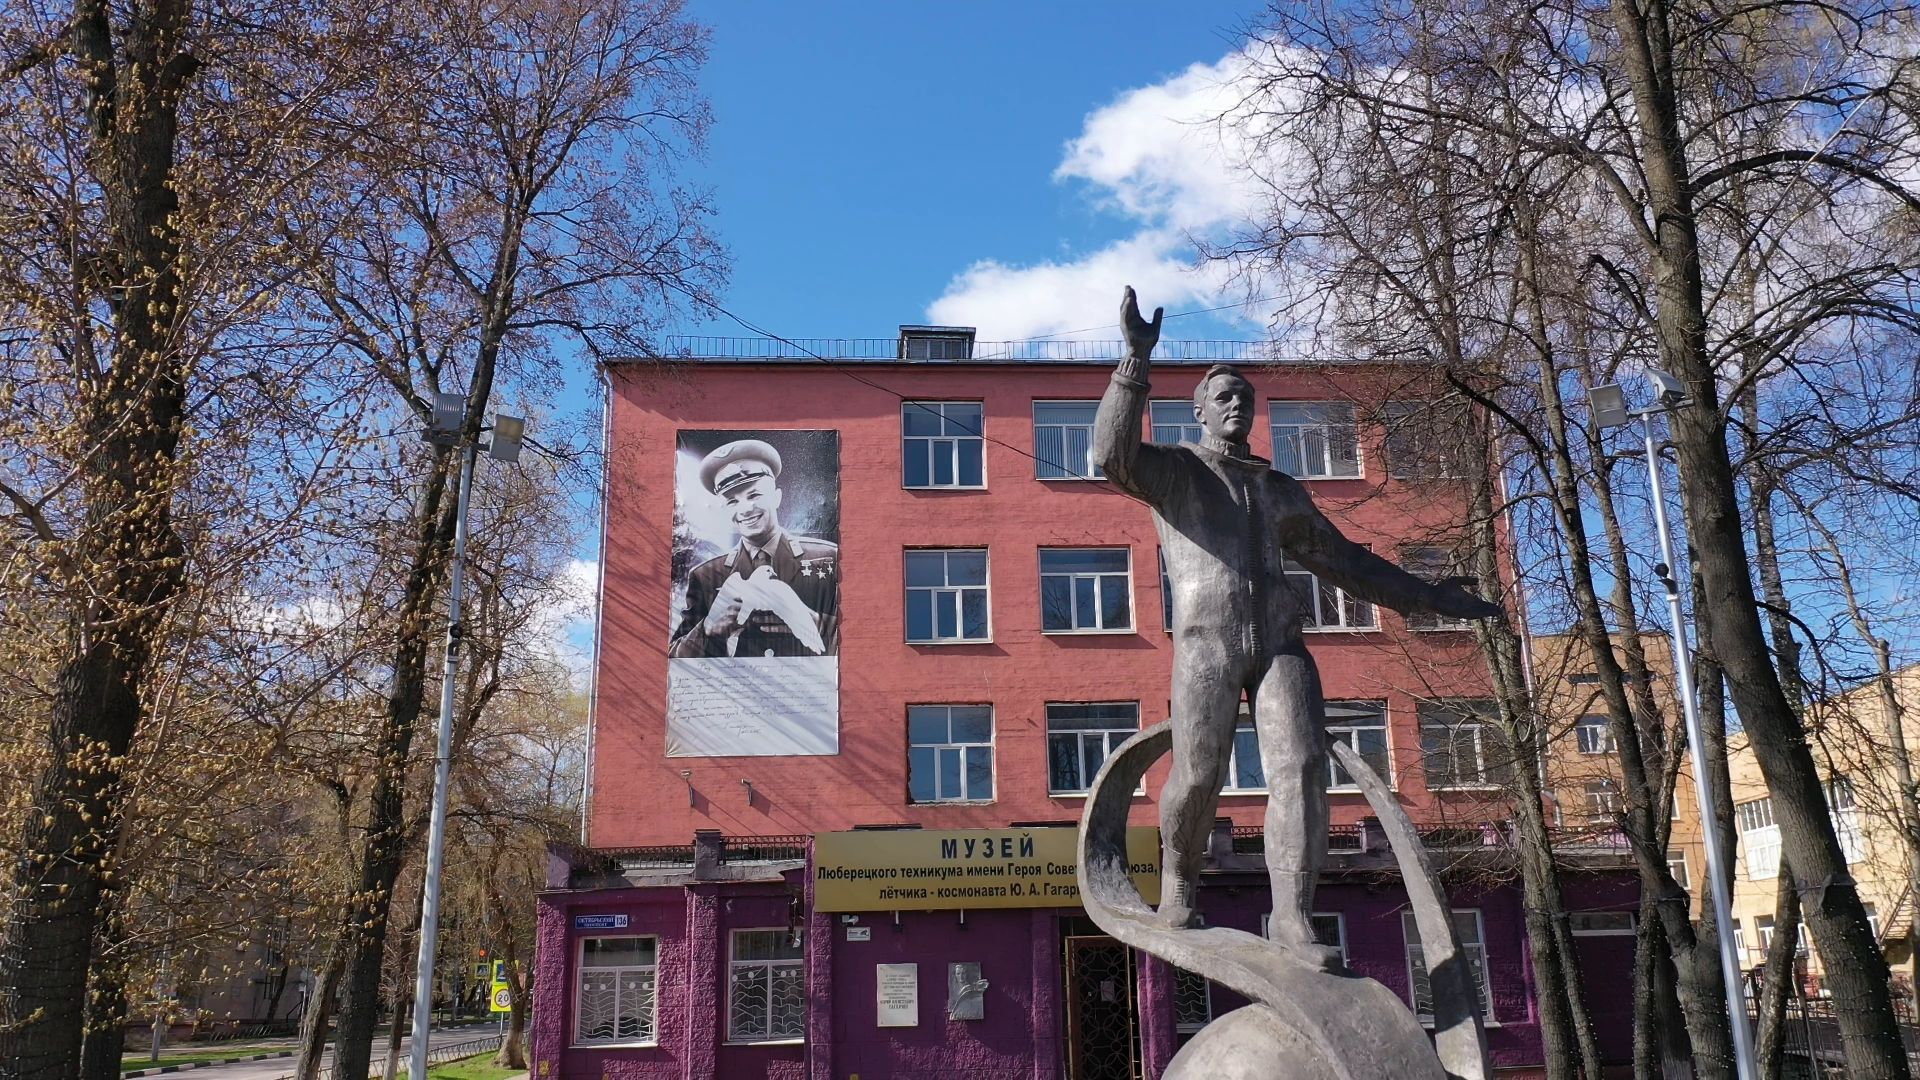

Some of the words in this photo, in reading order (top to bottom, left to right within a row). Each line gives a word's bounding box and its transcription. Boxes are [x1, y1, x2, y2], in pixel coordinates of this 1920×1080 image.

[941, 833, 1034, 859] МУЗЕЙ
[817, 866, 897, 882] Люберецкого
[901, 866, 963, 880] техникума
[967, 865, 1004, 876] имени
[1008, 863, 1041, 878] Героя
[1130, 863, 1158, 877] юза,
[879, 886, 927, 899] лётчика
[937, 885, 1006, 898] космонавта
[1010, 883, 1025, 896] Ю.
[1029, 883, 1040, 896] А.
[1043, 882, 1079, 898] Гагар
[616, 916, 627, 926] 136
[497, 994, 509, 1004] 20
